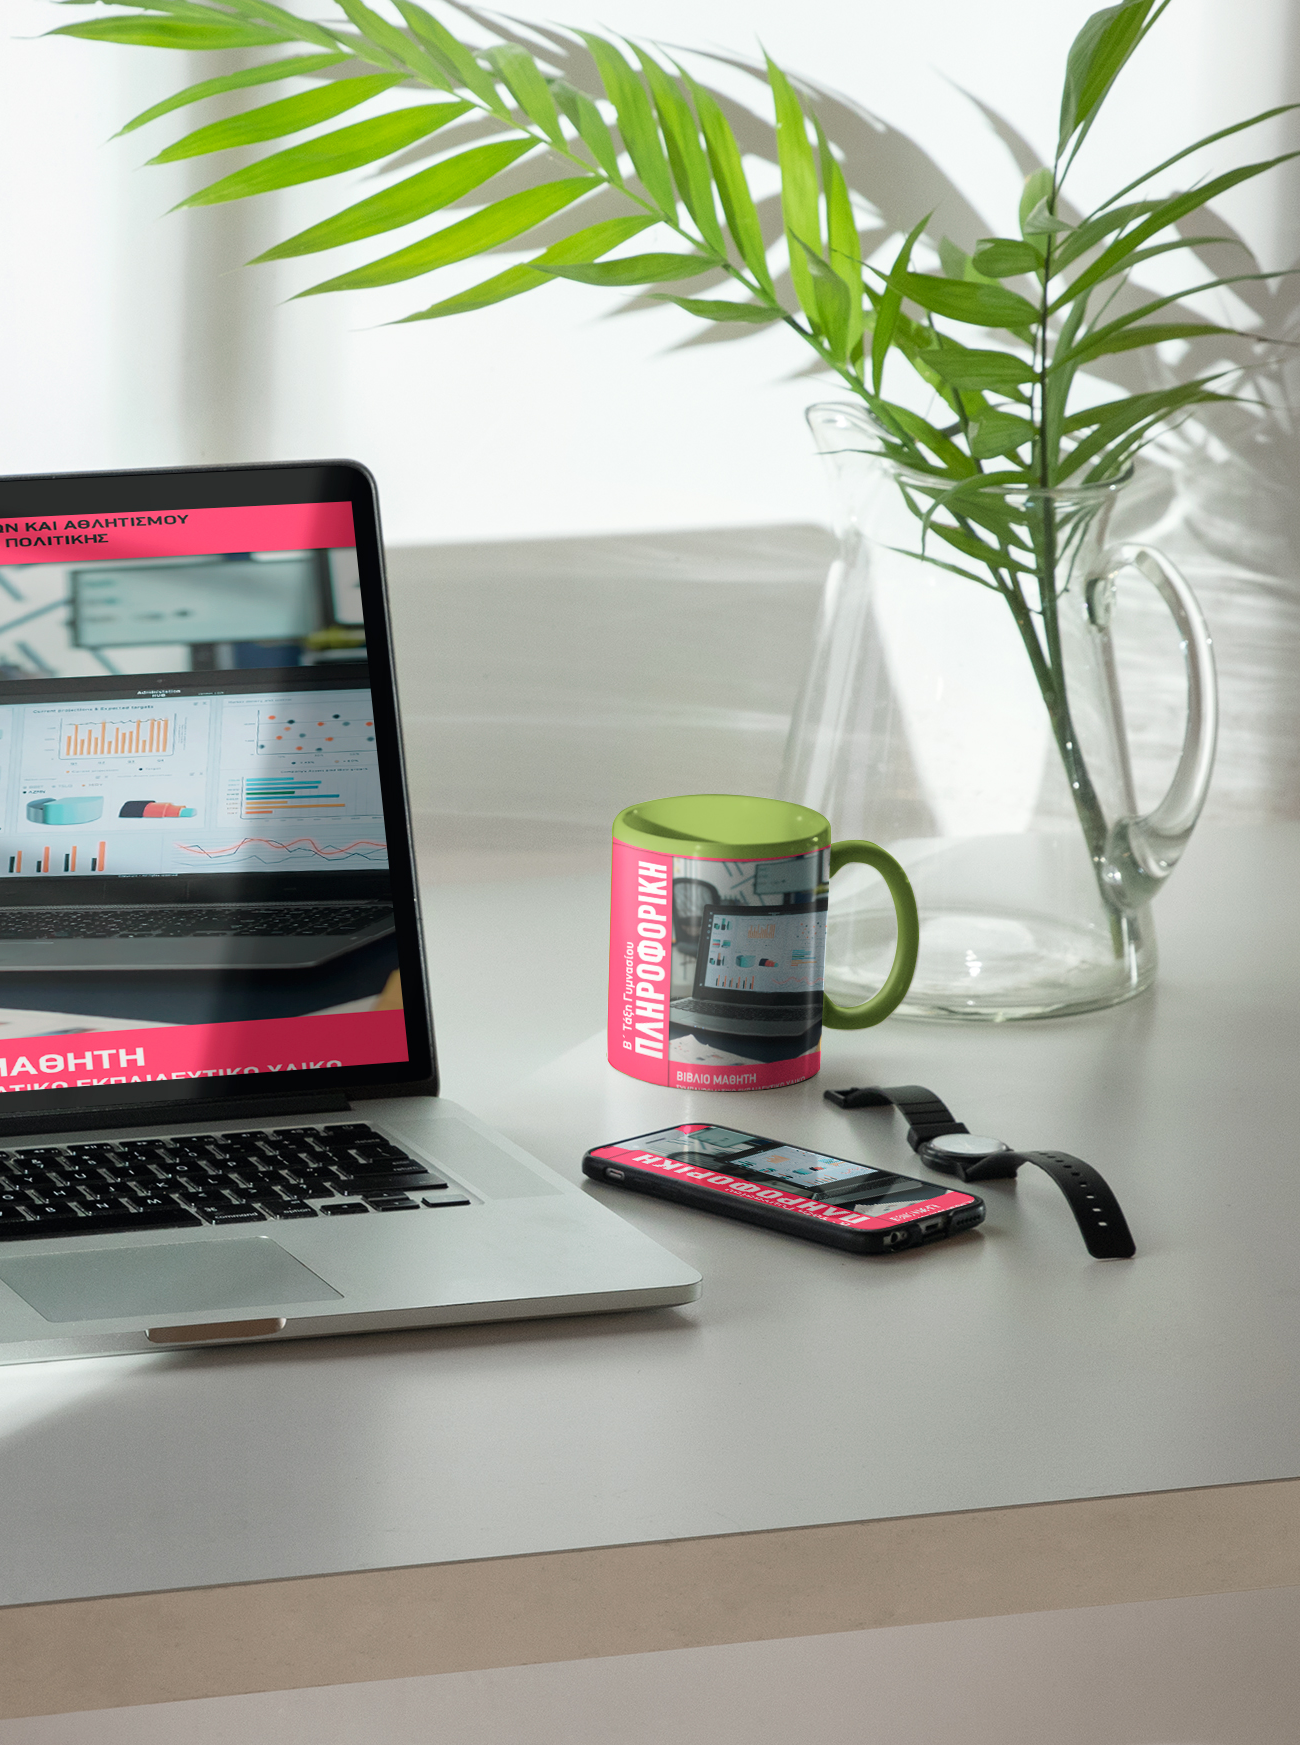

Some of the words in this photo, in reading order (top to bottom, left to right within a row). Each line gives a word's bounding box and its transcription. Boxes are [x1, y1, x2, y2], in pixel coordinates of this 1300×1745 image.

[25, 521, 57, 533] ΚΑΙ
[64, 514, 189, 531] ΑΘΛΗΤΙΣΜΟΥ
[6, 533, 109, 548] ΠΟΛΙΤΙΚΗΣ
[623, 941, 635, 1001] Γυμνασίου
[635, 861, 667, 1059] ΠΛΗΡΟΦΟΡΙΚΗ
[622, 1004, 635, 1031] Τάξη
[676, 1071, 711, 1085] ΒΙΒΛΙΟ
[713, 1073, 757, 1086] ΜΑΘΗΤΗ
[632, 1153, 870, 1224] ΠΛΗΡΟΦΟΡΙΚΗ
